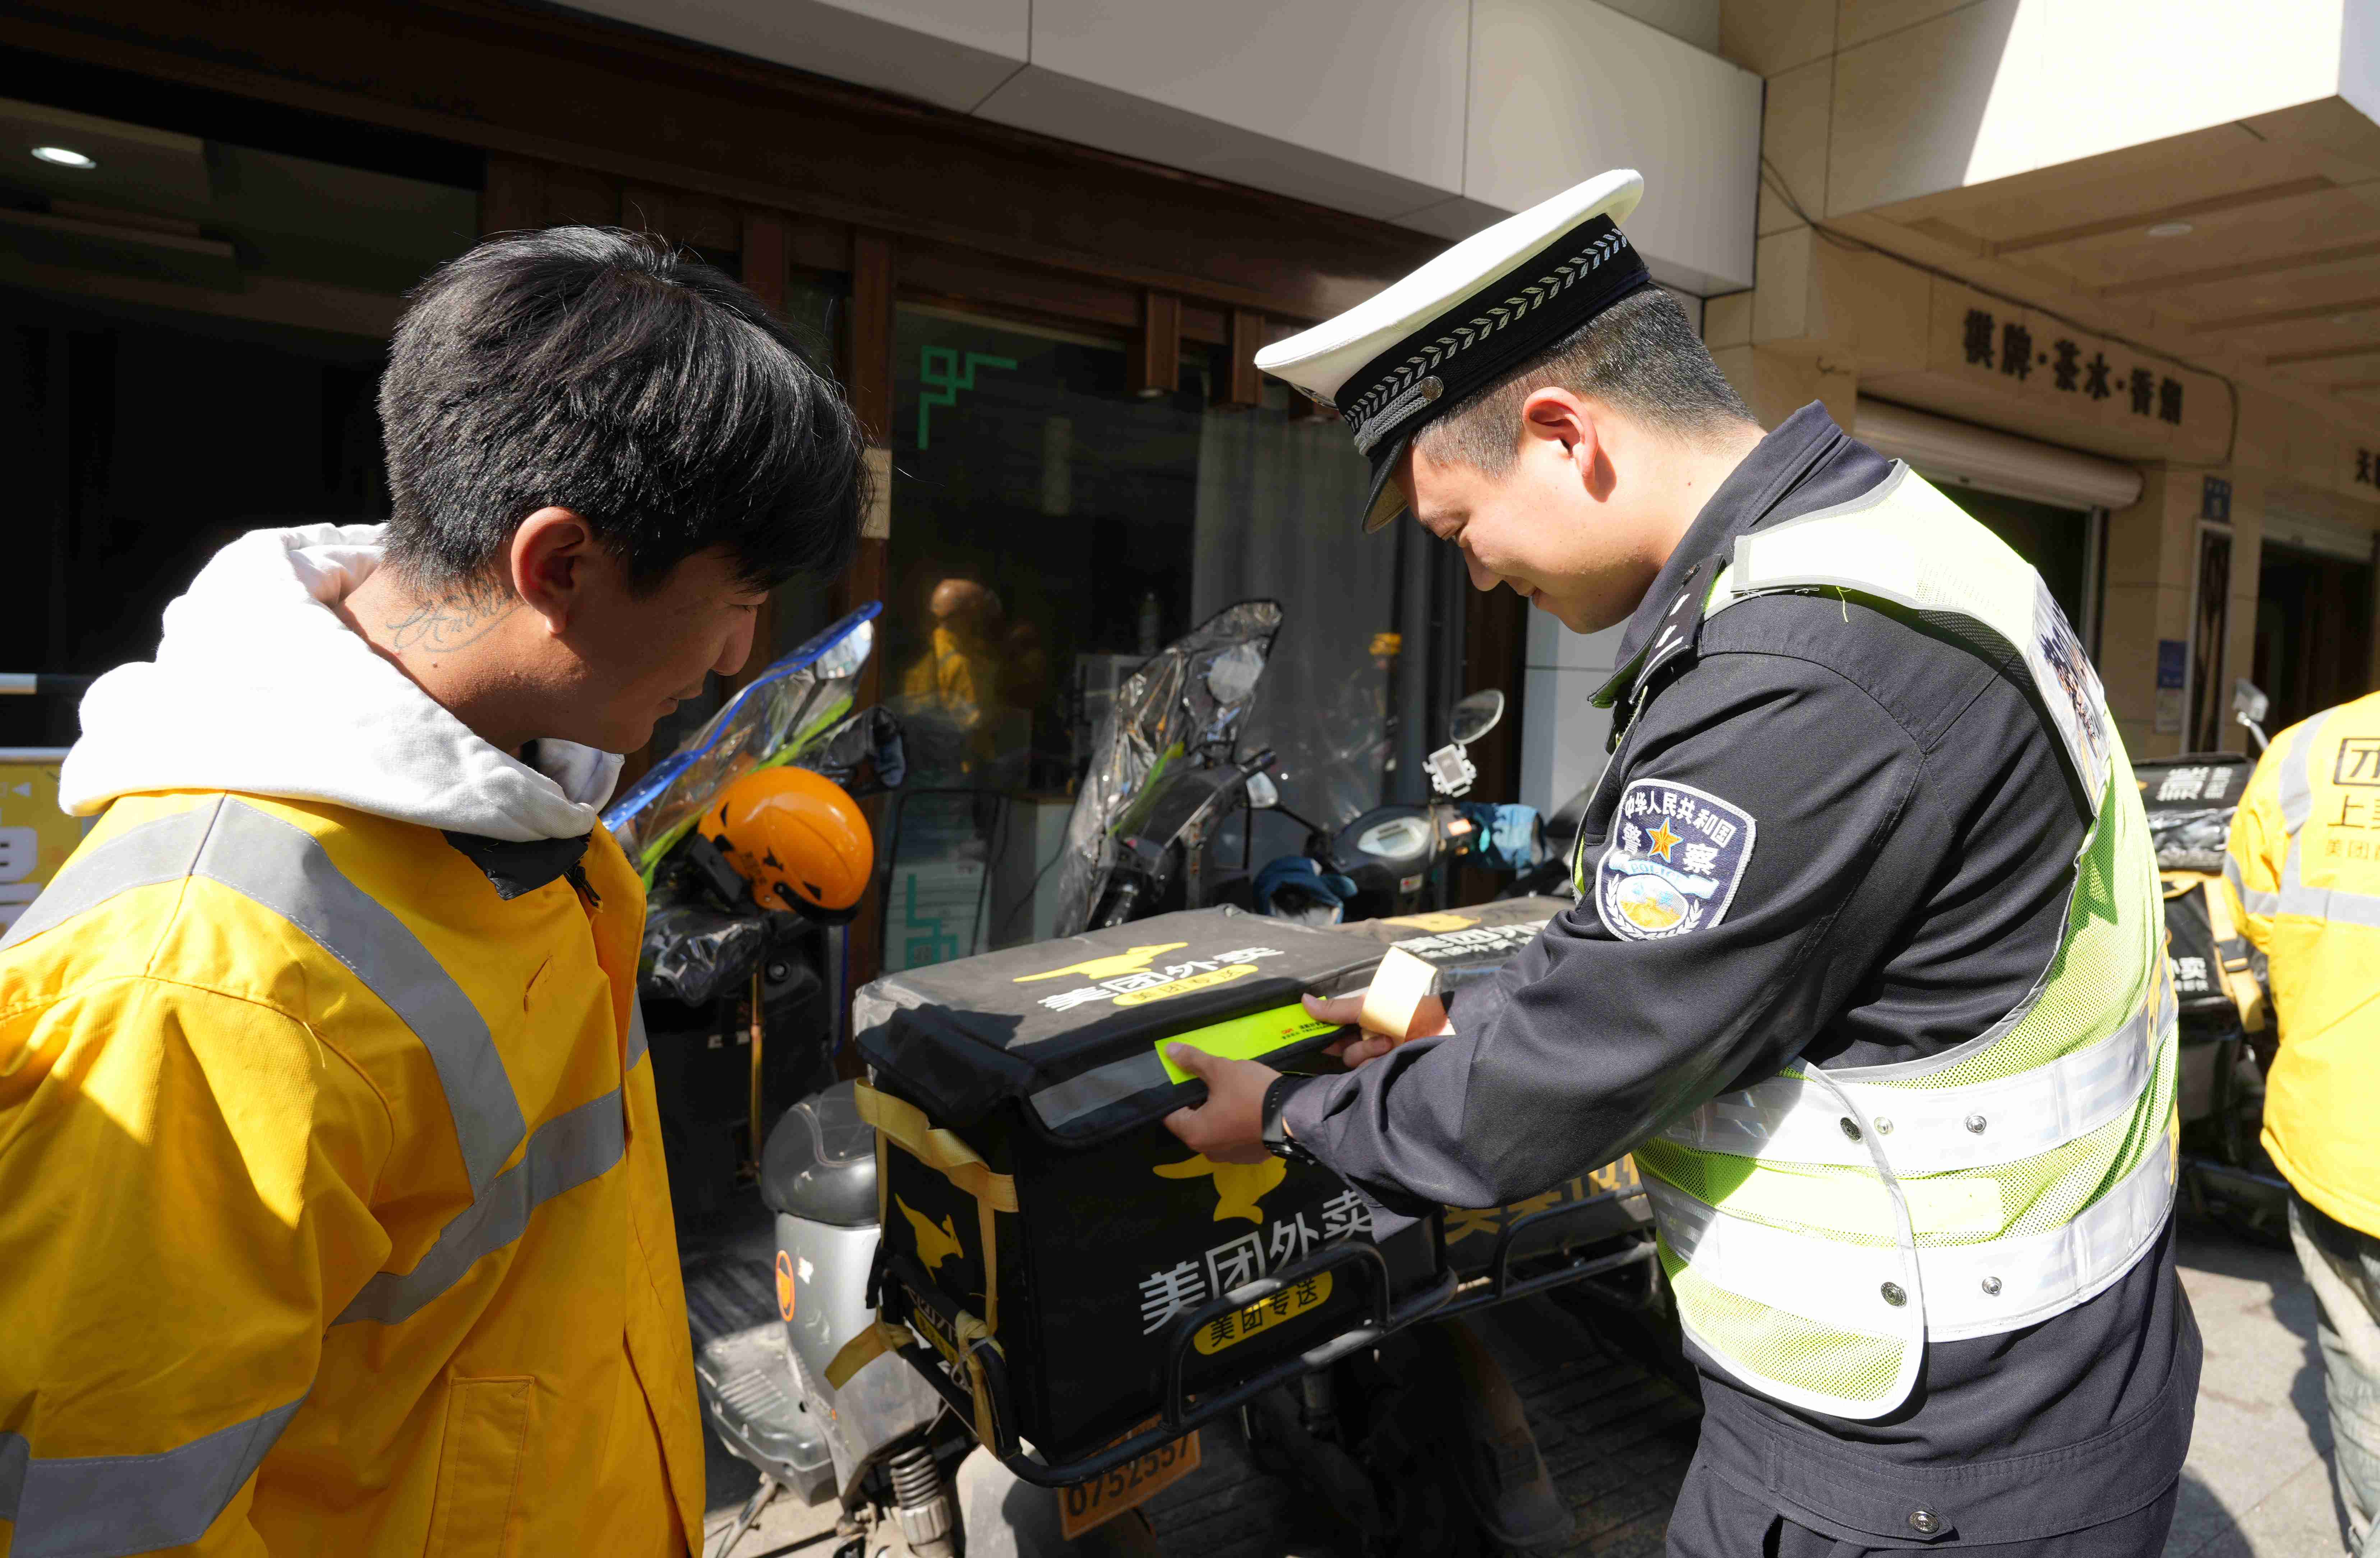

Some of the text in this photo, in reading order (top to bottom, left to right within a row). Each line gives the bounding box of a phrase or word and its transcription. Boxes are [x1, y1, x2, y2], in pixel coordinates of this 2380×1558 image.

[1625, 790, 1736, 848] 中华人民共和国
[2327, 794, 2380, 829] 上
[1623, 822, 1719, 875] 警 察
[2325, 839, 2380, 860] 美团
[1037, 947, 1285, 1011] 美团外卖
[1139, 1189, 1373, 1335] 美团外卖
[1210, 1278, 1319, 1348] 美团专送
